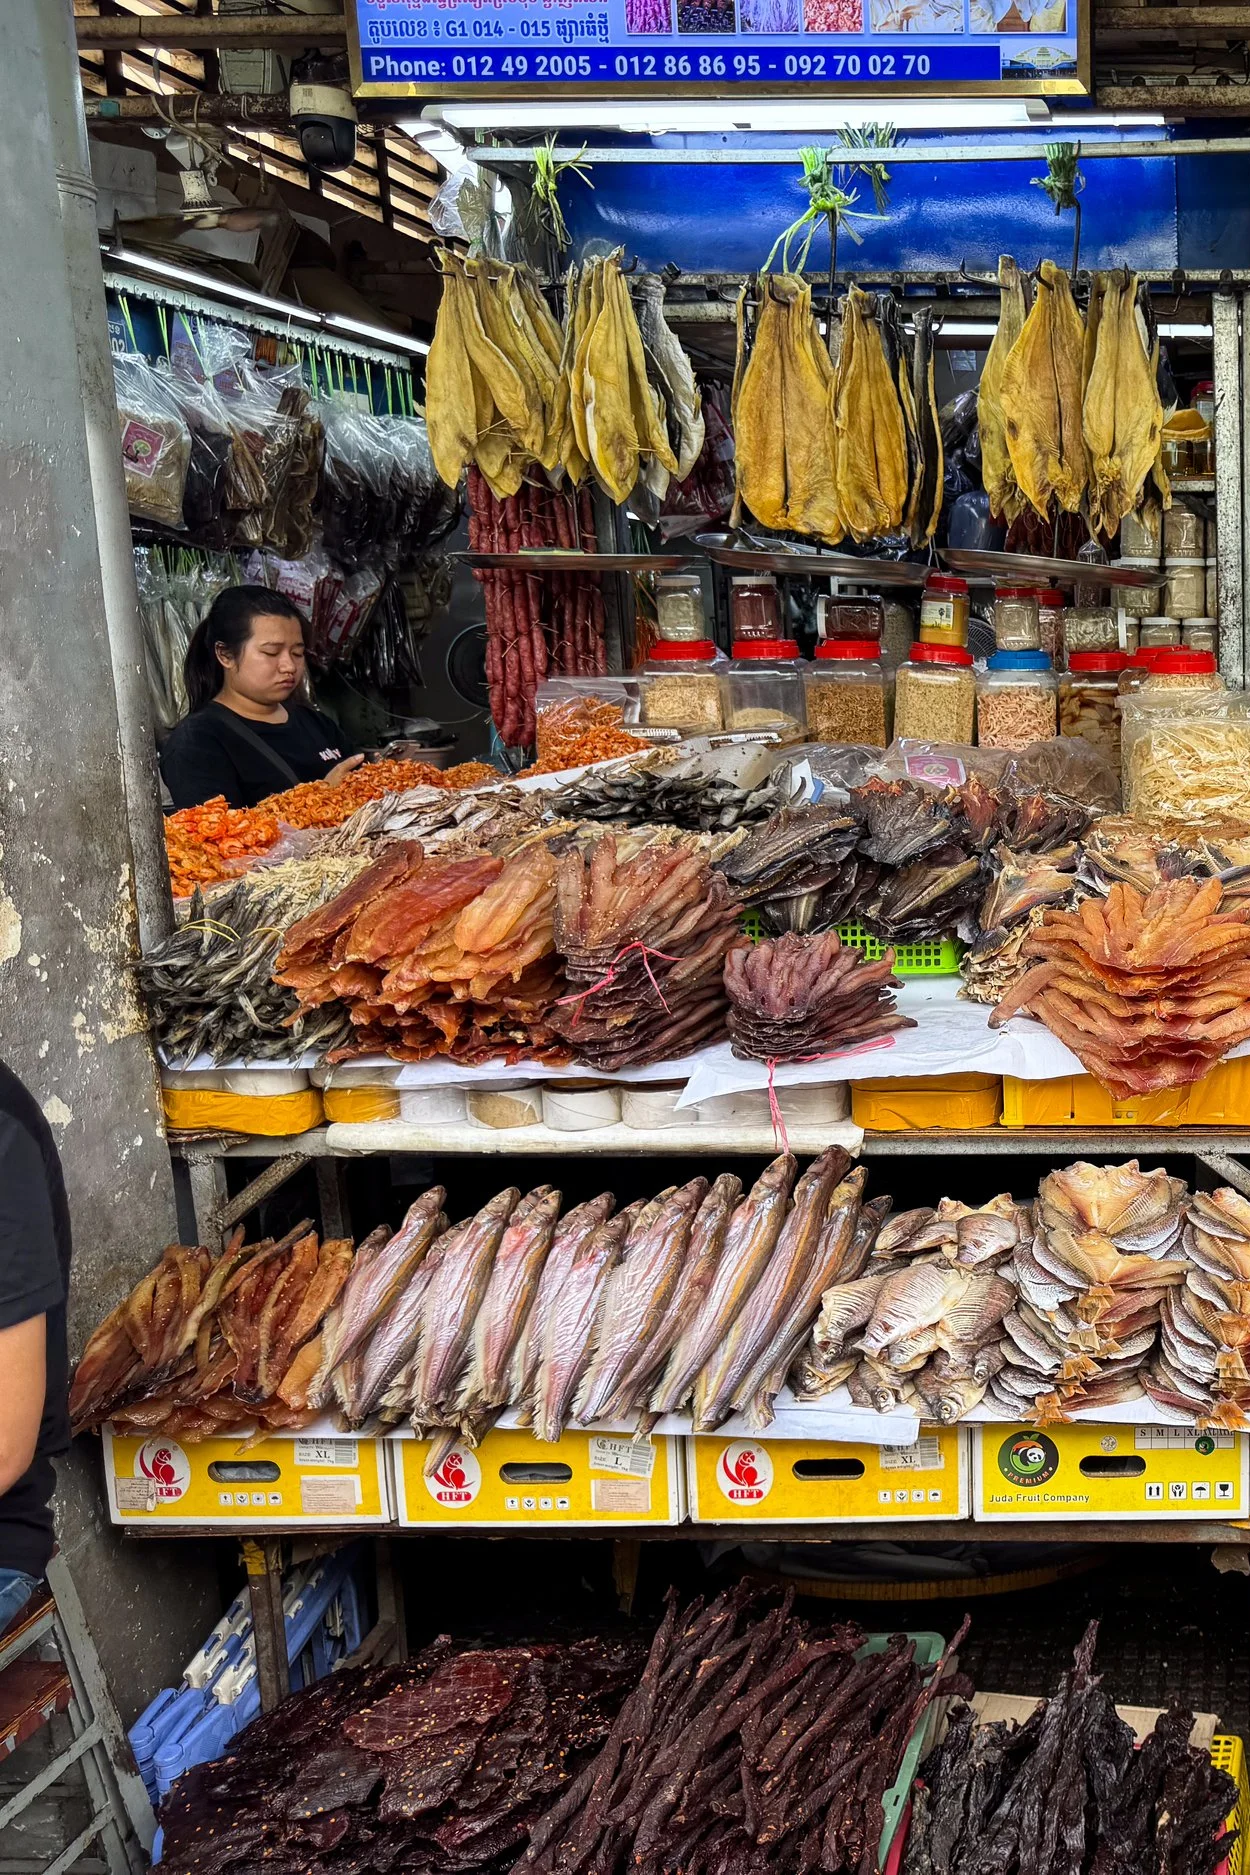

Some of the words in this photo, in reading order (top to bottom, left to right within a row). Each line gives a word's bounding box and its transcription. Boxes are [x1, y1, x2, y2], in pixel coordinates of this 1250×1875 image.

[446, 20, 468, 37] G1
[473, 20, 503, 37] 014
[520, 20, 551, 37] 015
[370, 56, 446, 76] Phone:
[452, 56, 494, 76] 012
[501, 56, 528, 75] 49
[535, 56, 591, 75] 2005
[615, 55, 656, 75] 012
[664, 55, 691, 75] 86
[698, 55, 726, 75] 86
[733, 55, 761, 75] 95
[784, 55, 826, 75] 092
[833, 55, 861, 75] 70
[868, 55, 896, 75] 02
[902, 55, 930, 75] 70
[1140, 1429, 1146, 1437] S
[1156, 1429, 1164, 1437] M
[1174, 1429, 1180, 1437] L
[1187, 1428, 1200, 1436] XL
[610, 1443, 632, 1453] HFT
[315, 1450, 330, 1459] XL
[901, 1455, 916, 1464] XL
[615, 1456, 623, 1466] L
[1008, 1471, 1050, 1484] PREMIUM
[441, 1492, 468, 1501] HFT
[733, 1489, 759, 1498] HFT
[990, 1494, 1013, 1503] Juda
[1016, 1494, 1040, 1502] Fruit
[1043, 1493, 1090, 1504] Company
